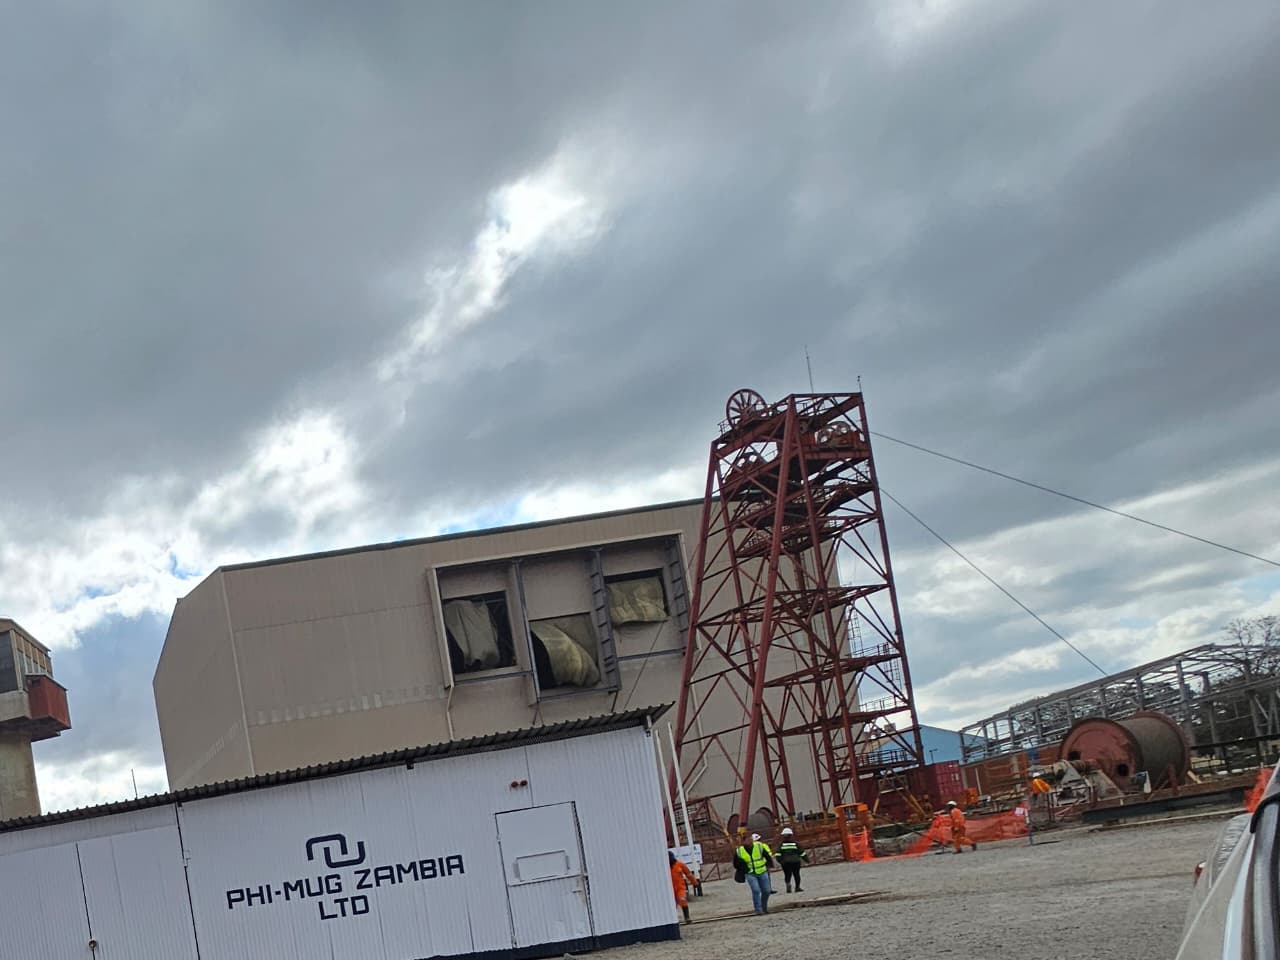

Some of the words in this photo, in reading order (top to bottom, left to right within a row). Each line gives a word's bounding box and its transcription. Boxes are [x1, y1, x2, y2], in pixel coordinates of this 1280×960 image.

[226, 873, 343, 909] PHI-MUG
[353, 854, 465, 891] ZAMBIA
[318, 895, 370, 920] LTD
